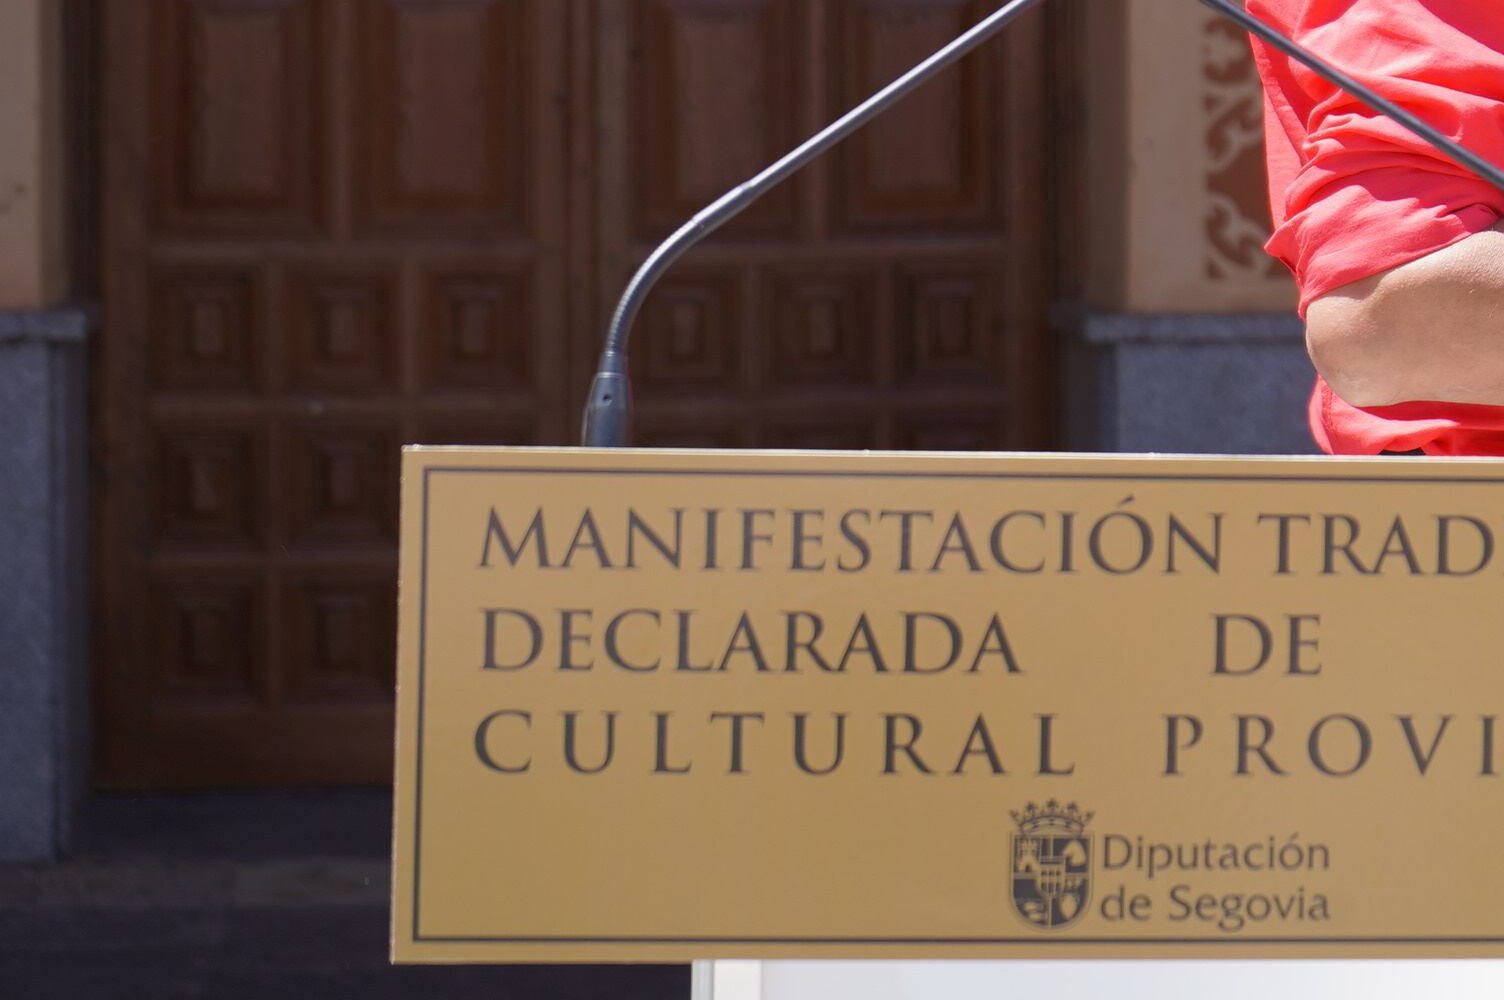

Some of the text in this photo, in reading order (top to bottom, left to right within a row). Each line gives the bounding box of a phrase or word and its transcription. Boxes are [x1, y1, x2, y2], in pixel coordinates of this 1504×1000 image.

[480, 496, 1222, 574] MANIFESTACIÓN
[483, 609, 1021, 674] DECLARADA
[1213, 615, 1320, 675] DE
[474, 710, 1074, 775] CULTURAL
[1104, 835, 1328, 878] Diputación
[1101, 885, 1328, 930] de Segovia
